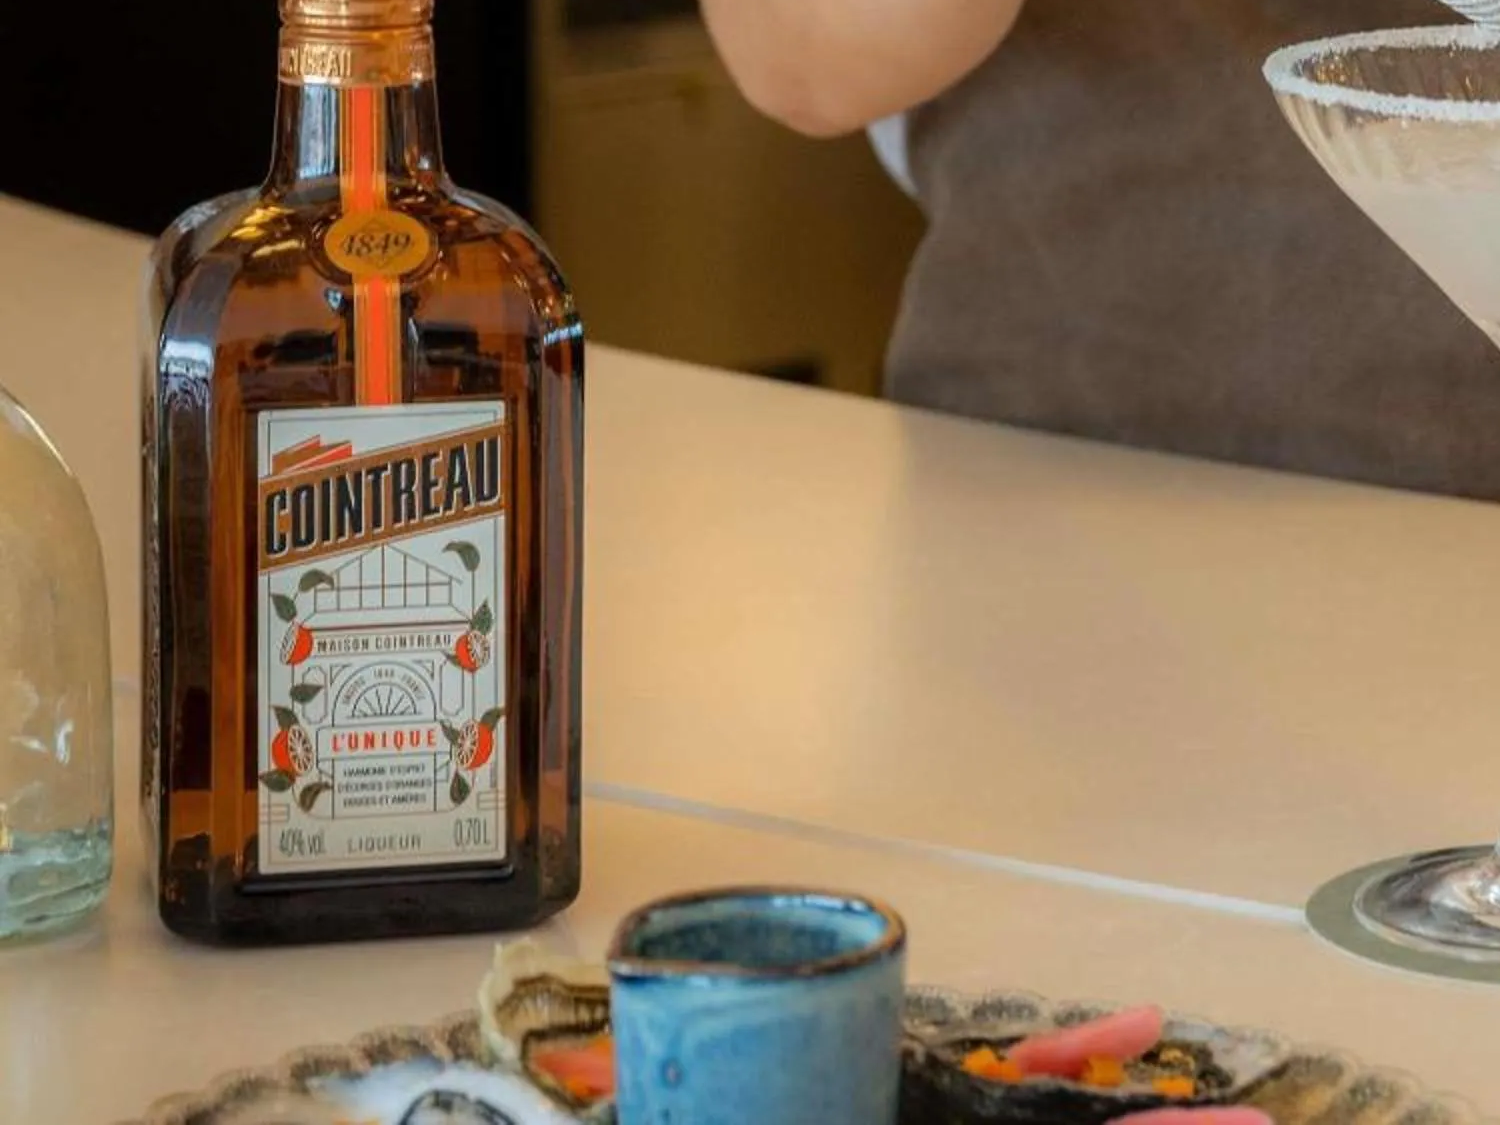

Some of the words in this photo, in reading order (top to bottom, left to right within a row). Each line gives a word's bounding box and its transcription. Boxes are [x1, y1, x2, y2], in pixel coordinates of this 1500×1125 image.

[342, 232, 412, 257] 1849
[265, 434, 501, 557] COINTREAU
[317, 637, 370, 652] MAISON
[375, 633, 452, 650] COINTREAU
[332, 729, 437, 753] L'UNIQUE
[346, 833, 421, 853] LIQUEUR
